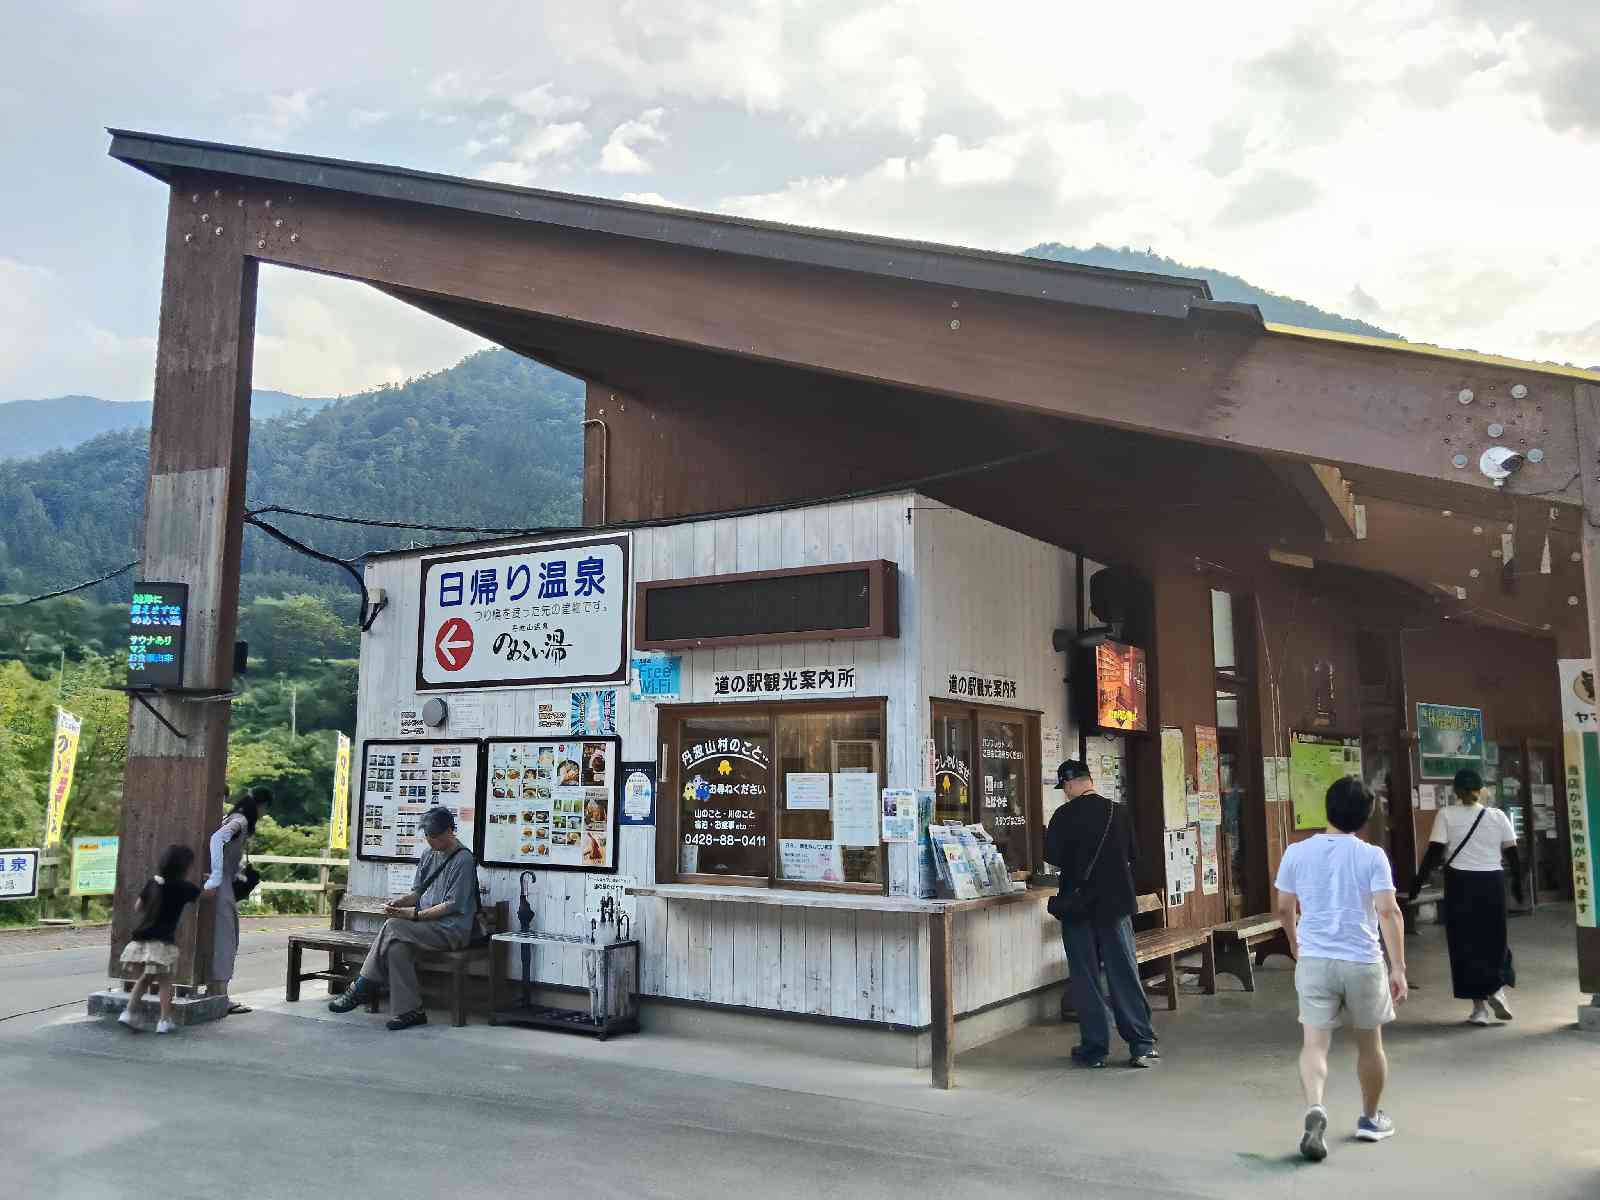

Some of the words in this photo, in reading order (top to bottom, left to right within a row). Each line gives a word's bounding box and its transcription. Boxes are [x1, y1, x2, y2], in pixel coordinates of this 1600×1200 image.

[439, 556, 606, 608] 日帰り温泉
[129, 635, 172, 646] サウナあり
[493, 629, 574, 667] のめこい湯
[638, 664, 672, 679] Free
[639, 679, 671, 694] Wi-Fi
[714, 668, 855, 695] 道の駅観光案内所
[948, 674, 1017, 699] 道の駅観光案内所
[708, 783, 767, 795] お尋ねください
[694, 809, 756, 819] 山のこと・川のこと
[685, 834, 767, 847] 0428-88-0411
[0, 857, 27, 872] 泉
